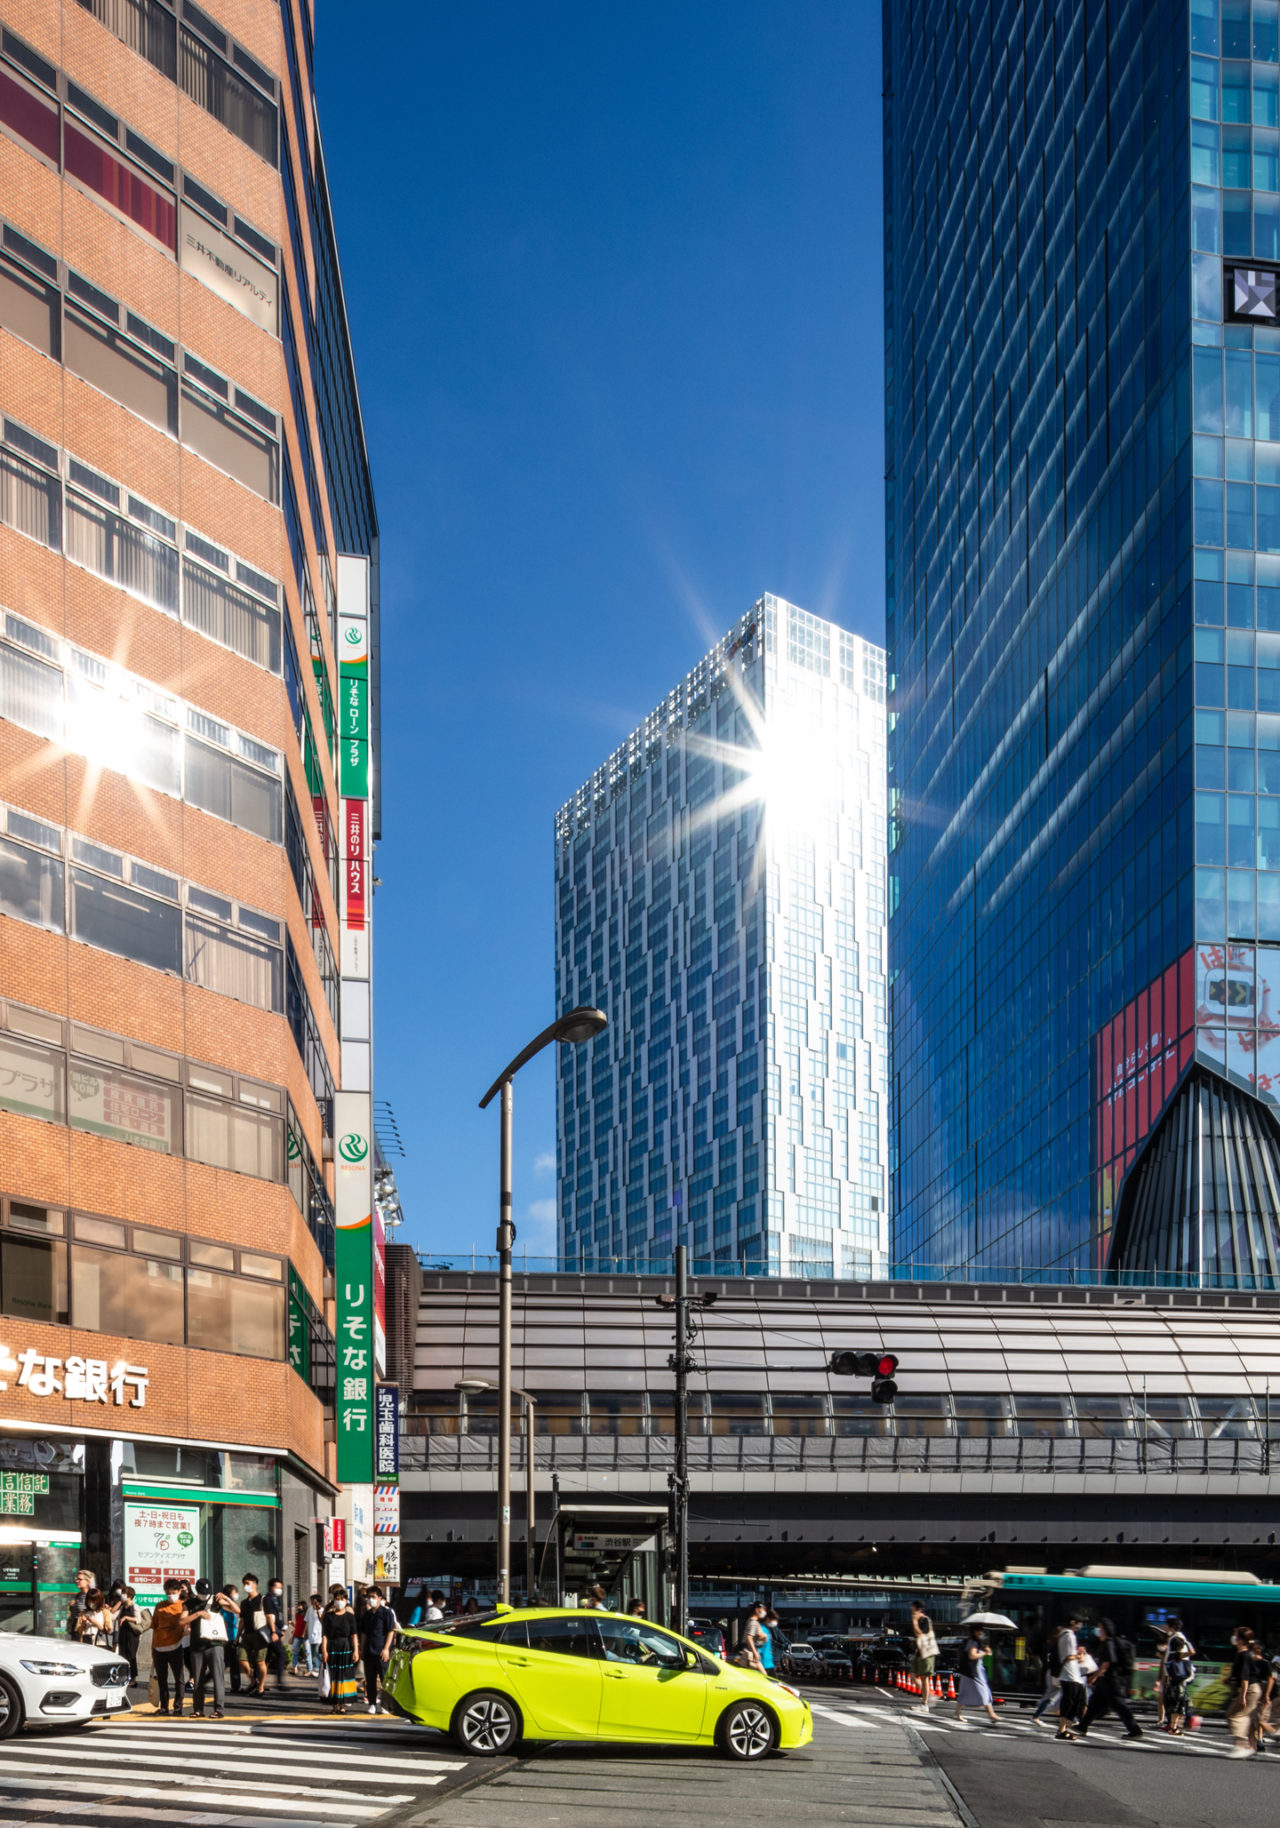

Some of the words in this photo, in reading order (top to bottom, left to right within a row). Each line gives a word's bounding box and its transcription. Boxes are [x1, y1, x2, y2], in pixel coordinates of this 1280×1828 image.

[350, 813, 360, 894] 三井のリハウス
[343, 1284, 367, 1431] りそな銀行
[378, 1395, 395, 1473] 児玉歯科医院
